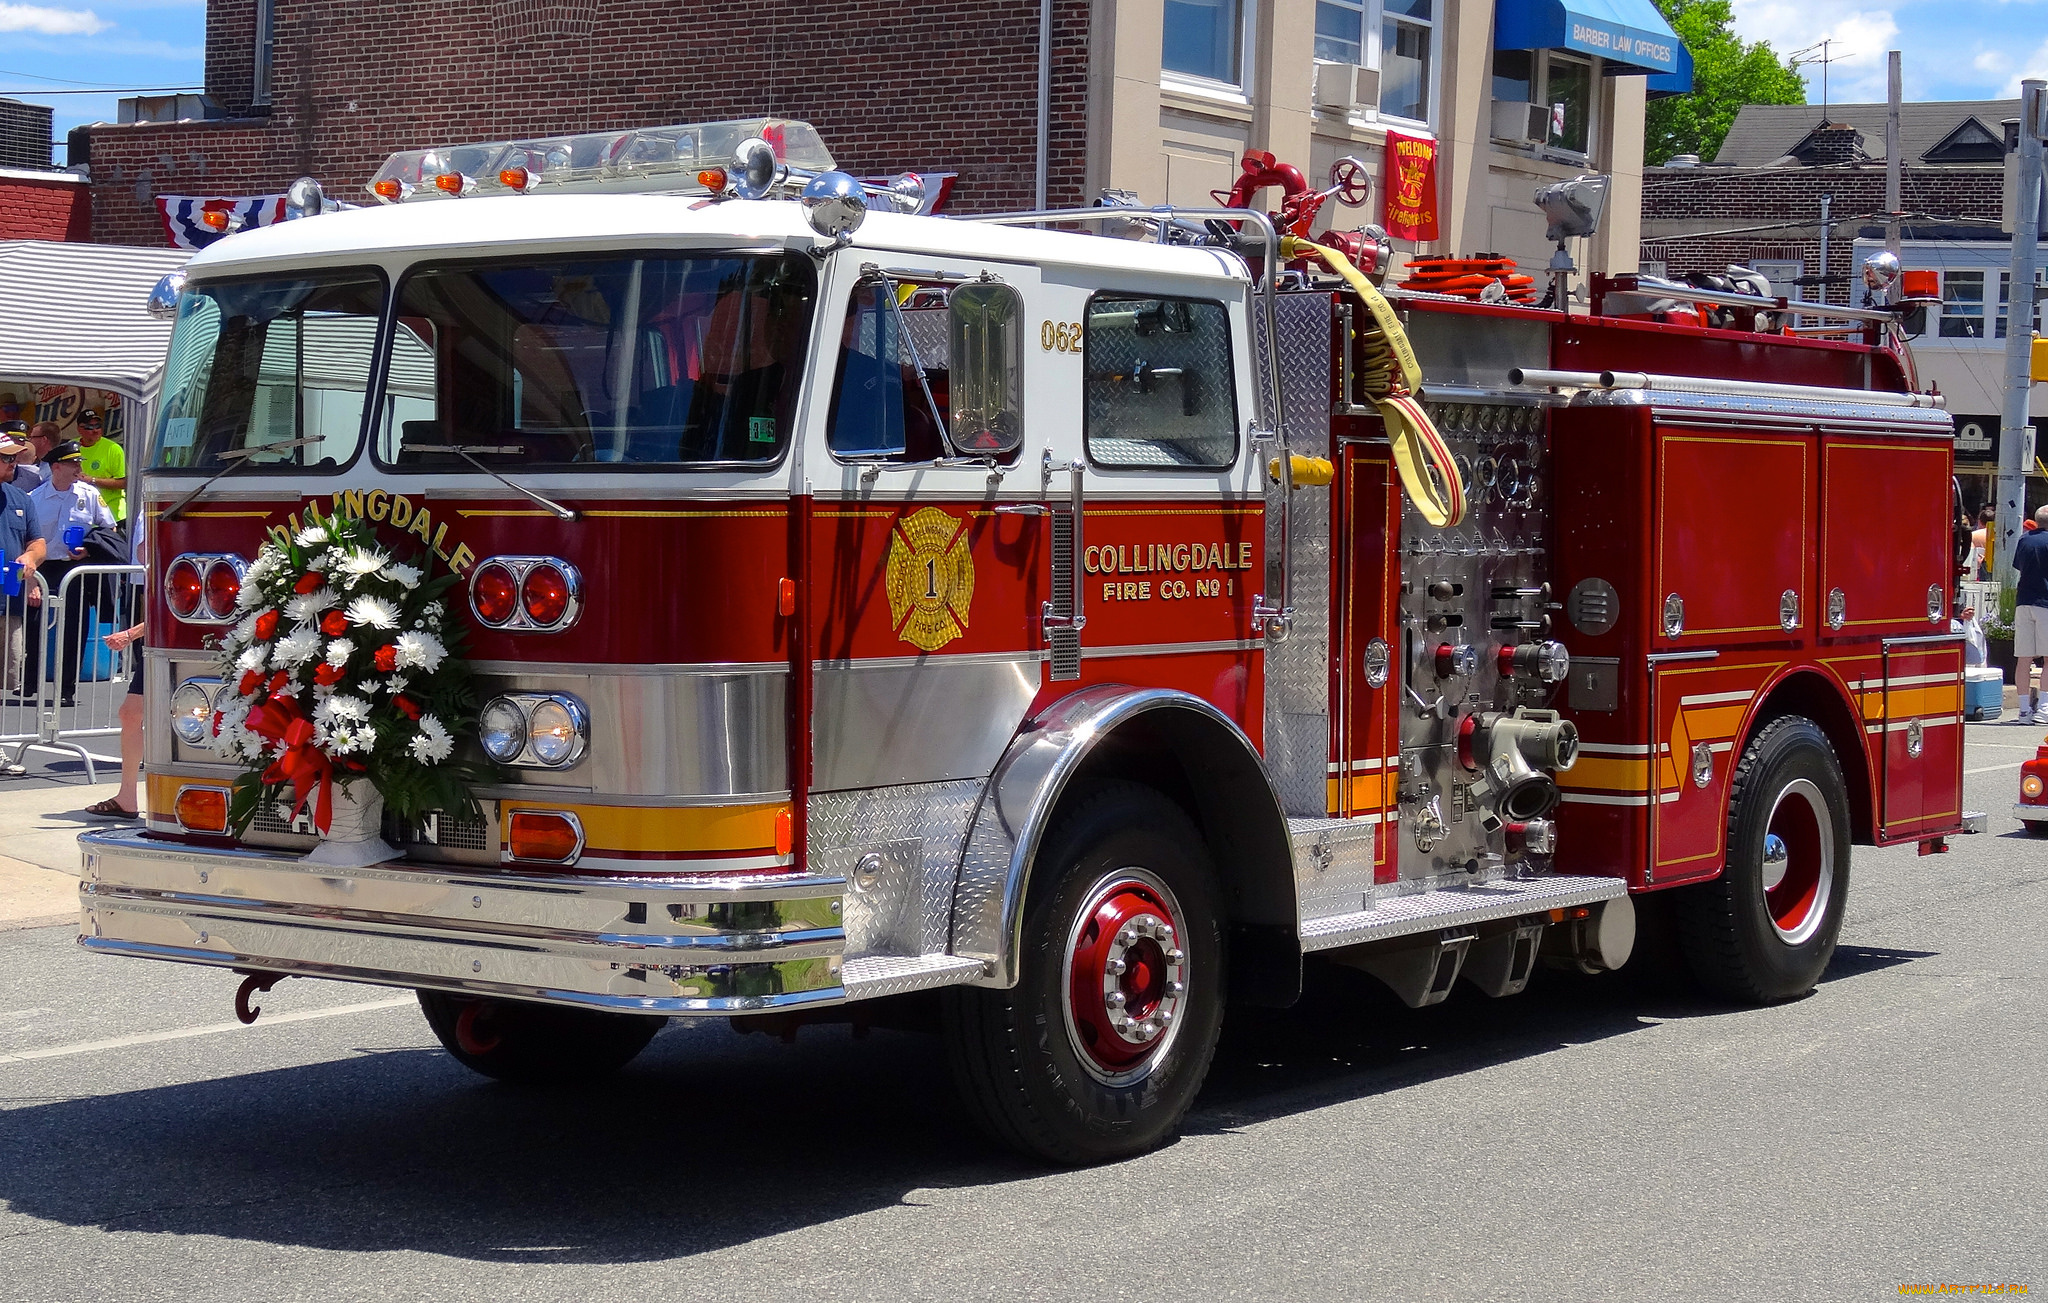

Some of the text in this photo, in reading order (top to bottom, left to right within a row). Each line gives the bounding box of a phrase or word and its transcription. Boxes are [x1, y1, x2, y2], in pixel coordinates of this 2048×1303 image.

[1573, 24, 1671, 62] BARBER LAW OFFICES
[1041, 319, 1082, 352] 062
[1084, 543, 1253, 573] COLLINGDALE
[925, 557, 938, 598] 1
[1103, 582, 1151, 601] FIRE
[1160, 580, 1191, 599] CO.
[1227, 579, 1233, 596] 1
[915, 620, 932, 634] FIRE
